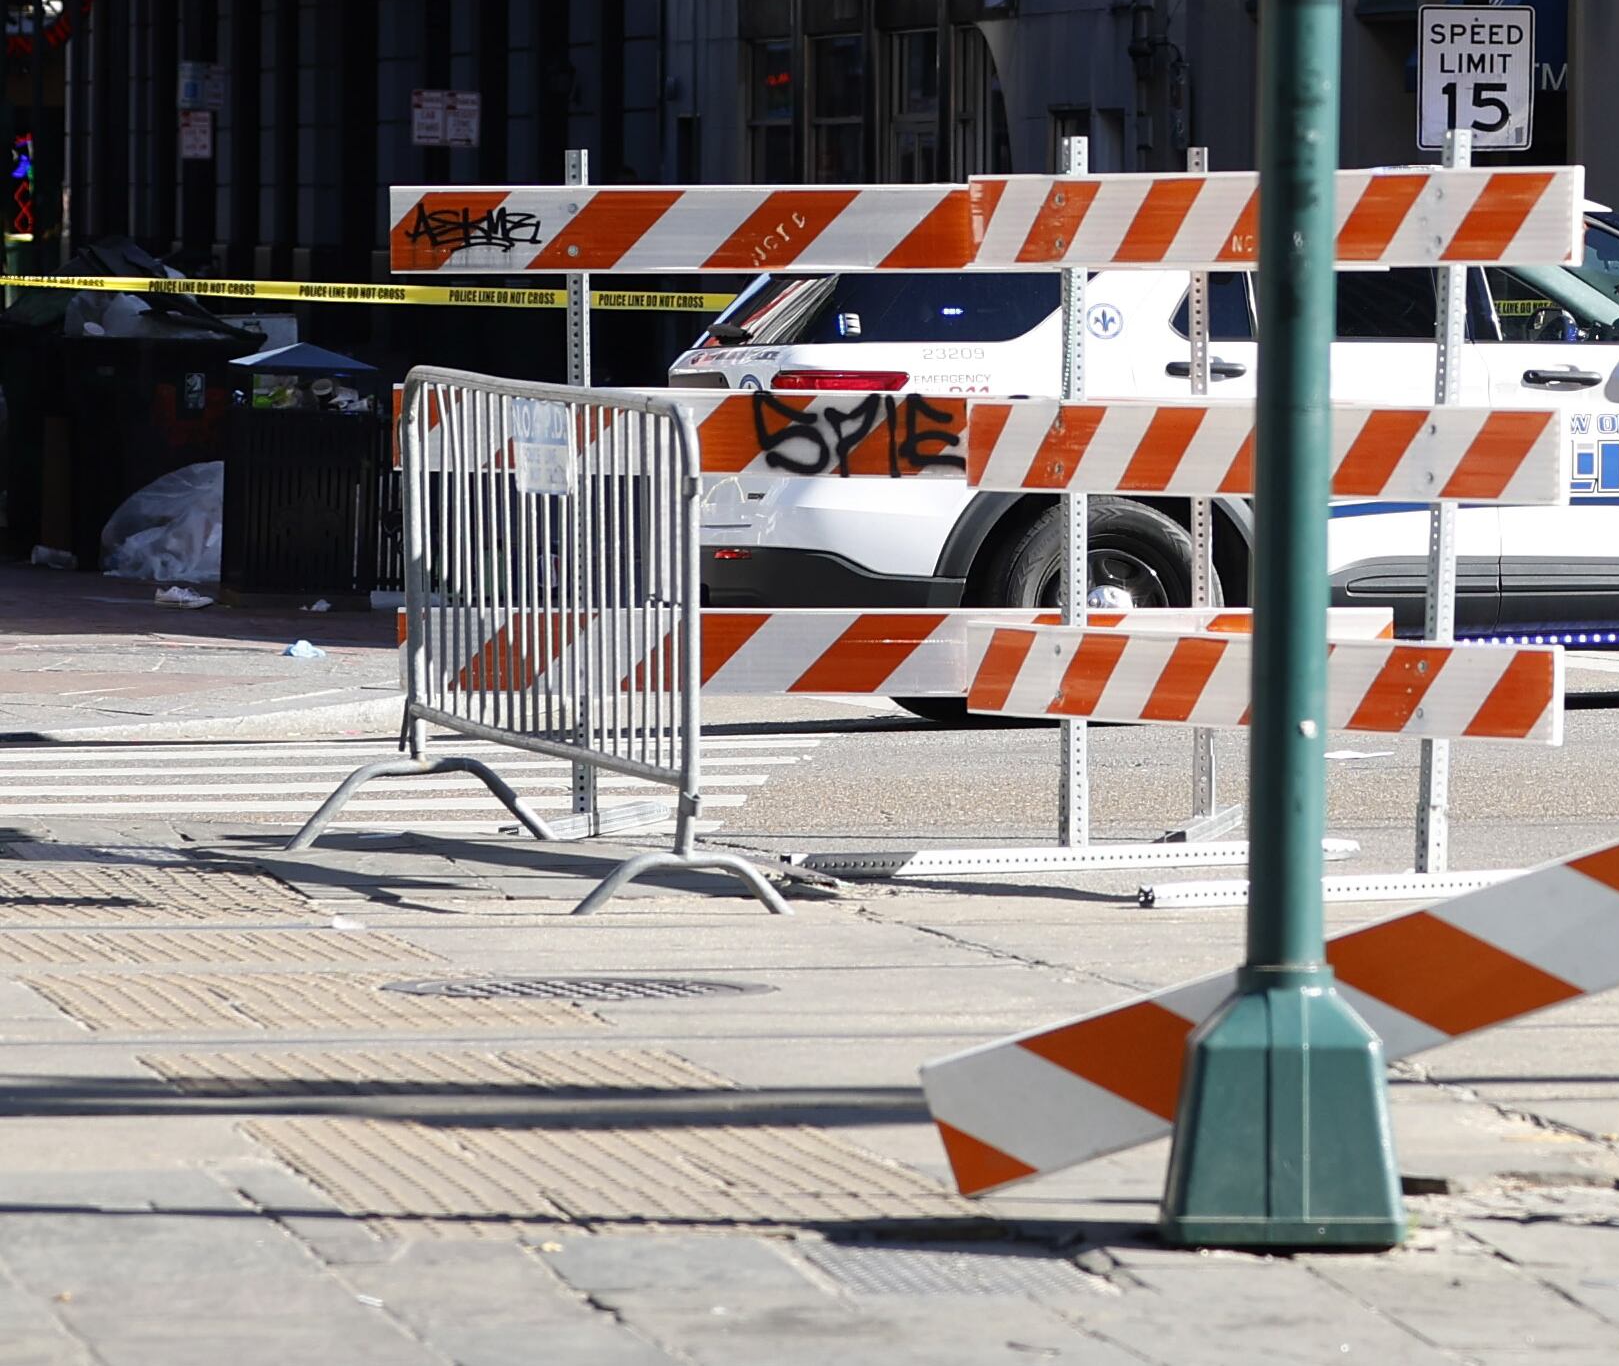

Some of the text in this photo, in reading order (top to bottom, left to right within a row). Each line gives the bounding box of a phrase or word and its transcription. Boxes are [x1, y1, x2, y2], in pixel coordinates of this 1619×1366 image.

[1430, 23, 1525, 45] SPEED
[1439, 52, 1513, 74] LIMIT
[1441, 82, 1511, 133] 15
[150, 280, 256, 296] POLICE LINE DO NOT CROSS
[300, 285, 405, 300] POLICE LINE DO NOT CROSS
[449, 290, 555, 305] POLICE LINE DO NOT CROSS
[599, 293, 704, 308] POLICE LINE DO NOT CROSS
[1503, 302, 1519, 314] LINE
[1520, 301, 1532, 314] DO
[921, 347, 985, 360] 23209
[914, 374, 991, 384] EMERGENCY
